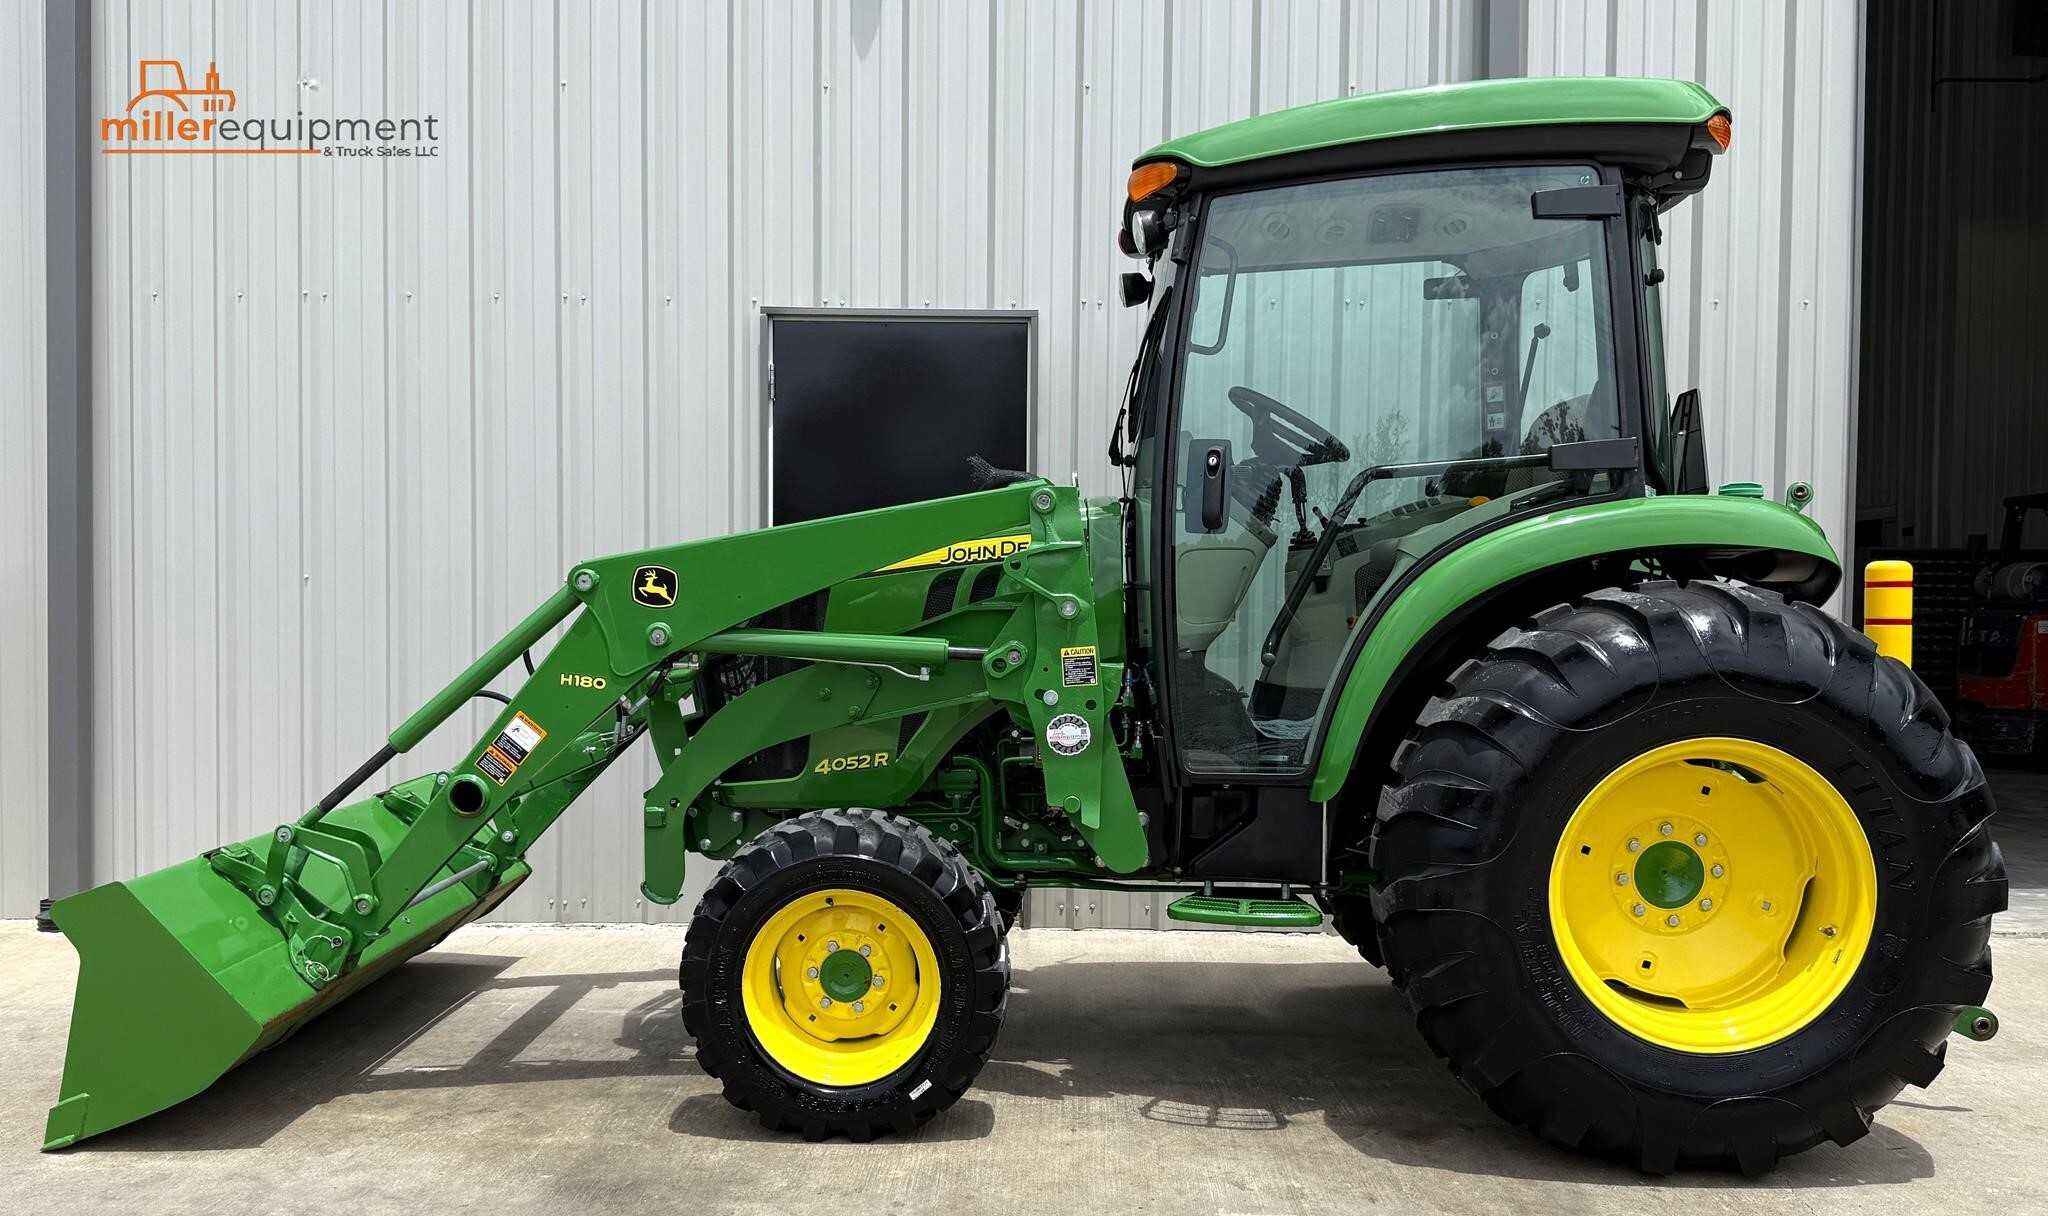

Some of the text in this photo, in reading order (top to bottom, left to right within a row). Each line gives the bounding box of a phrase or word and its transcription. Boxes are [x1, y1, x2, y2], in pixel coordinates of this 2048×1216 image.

[940, 544, 997, 563] JOHN
[1070, 648, 1094, 656] CAUTION
[560, 673, 607, 690] H180
[1831, 748, 1918, 894] TITAN
